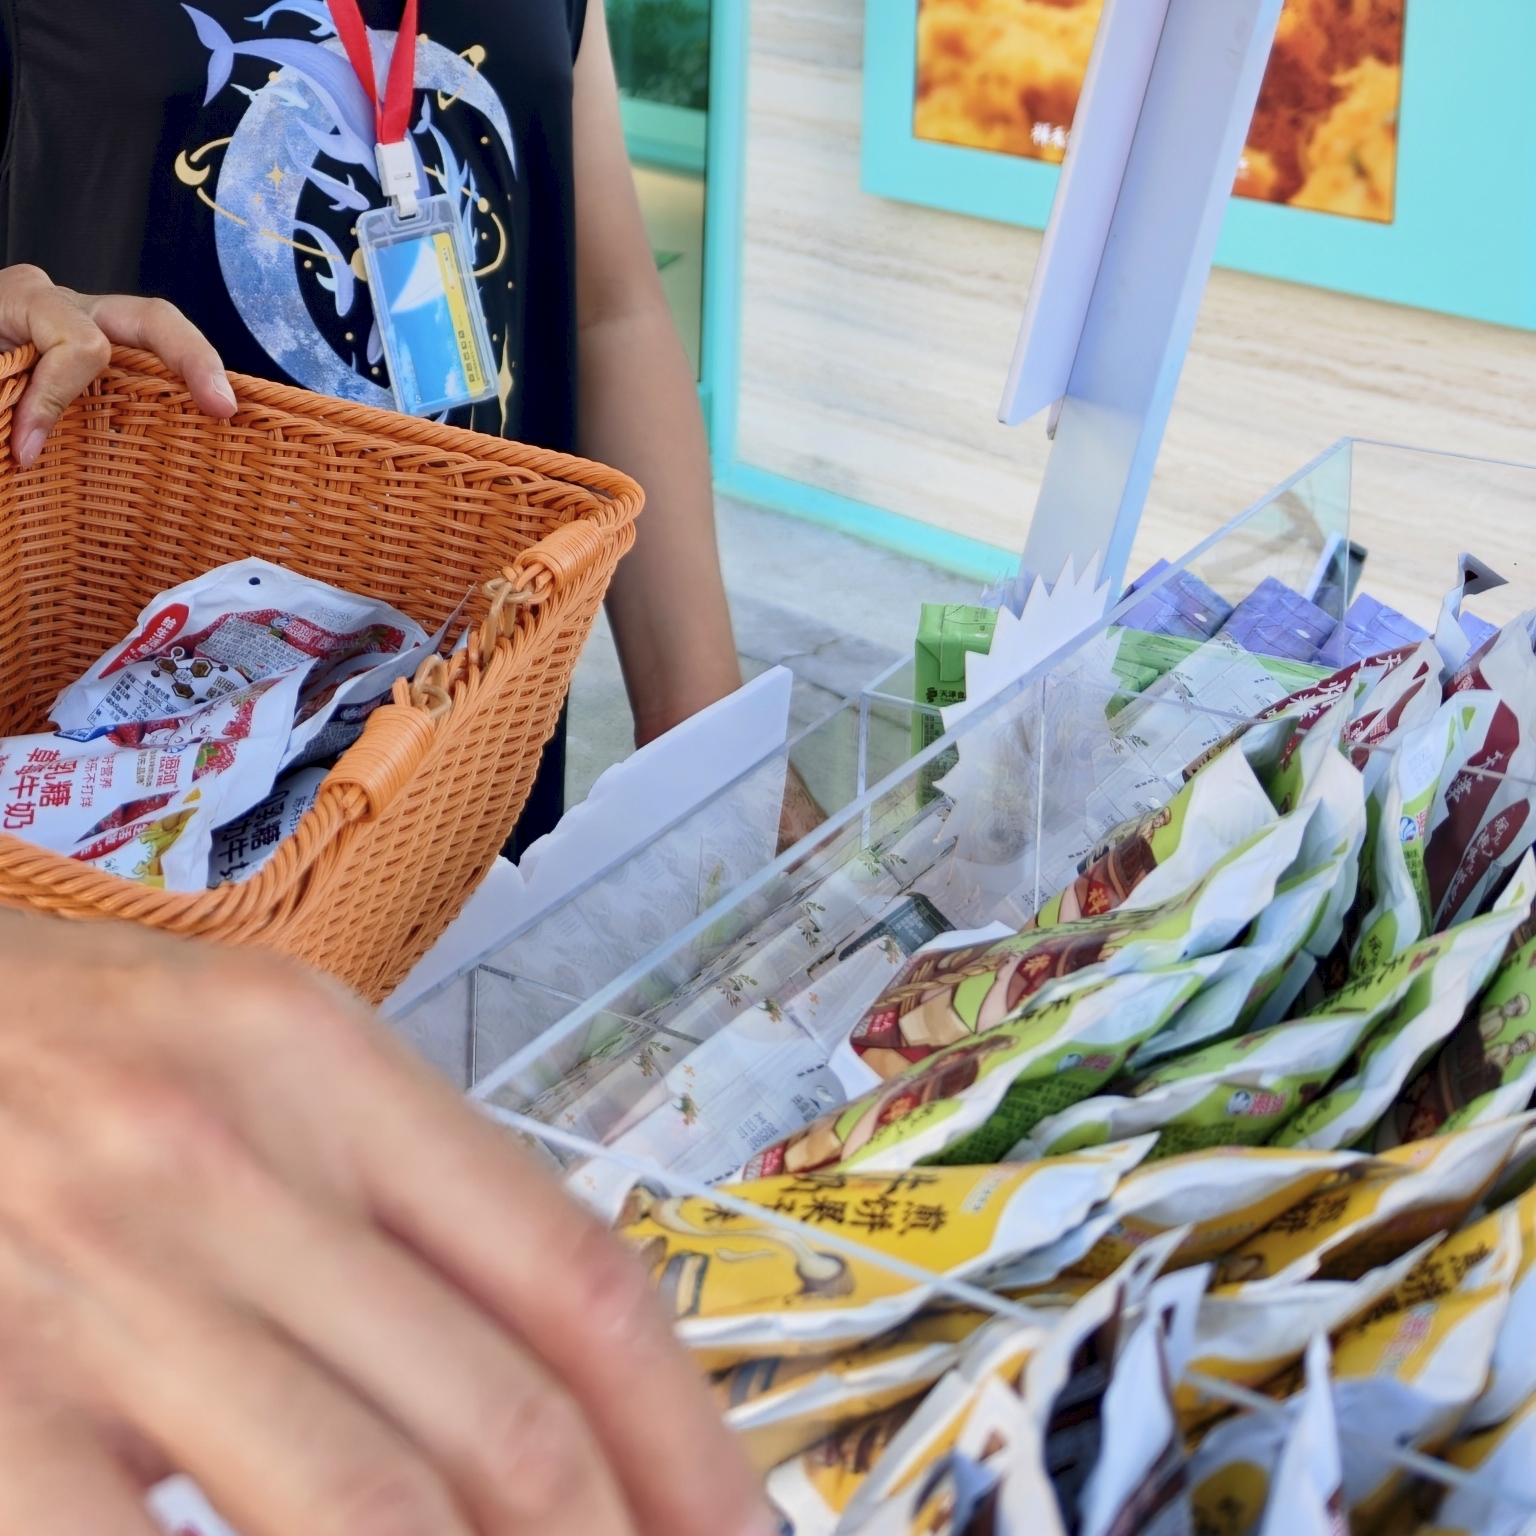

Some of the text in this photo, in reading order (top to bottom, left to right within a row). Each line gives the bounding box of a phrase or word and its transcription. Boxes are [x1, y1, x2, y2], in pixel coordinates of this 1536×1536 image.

[3, 747, 62, 829] 草莓牛奶
[163, 755, 182, 785] 海河
